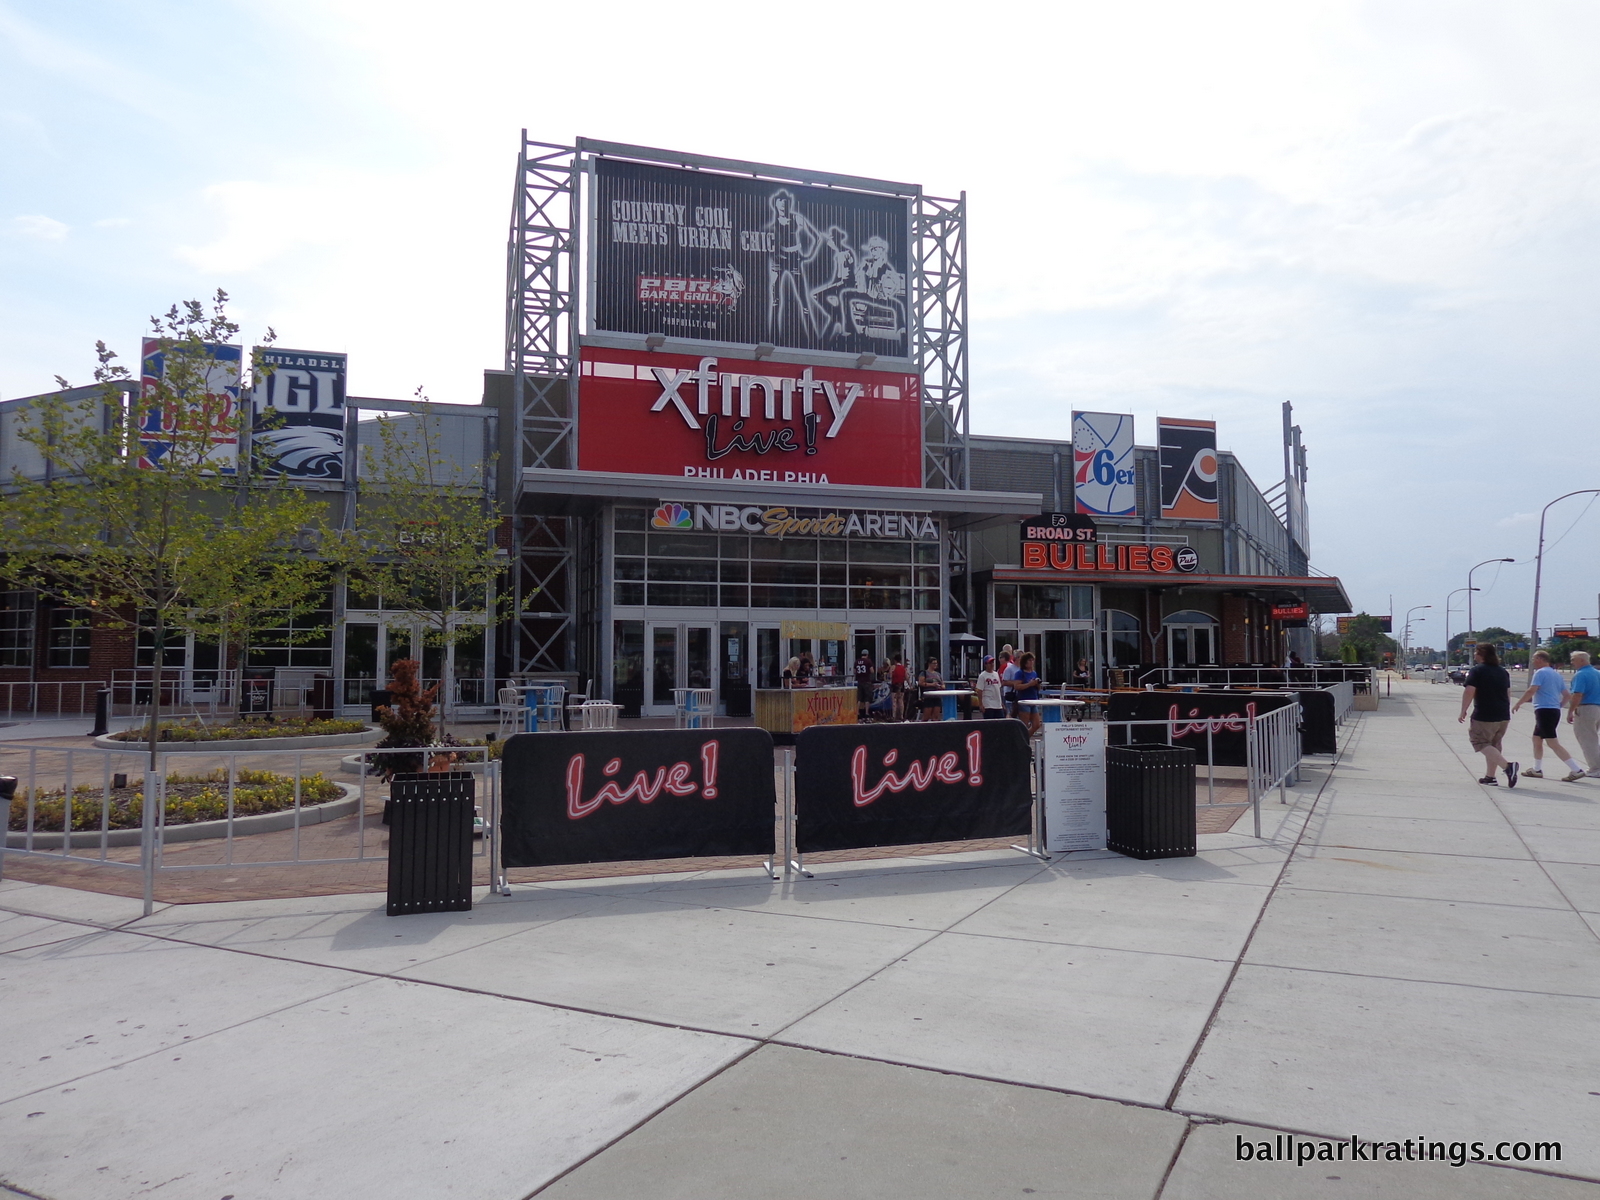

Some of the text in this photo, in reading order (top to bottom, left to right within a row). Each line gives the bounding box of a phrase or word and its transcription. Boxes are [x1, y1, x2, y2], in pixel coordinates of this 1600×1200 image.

[612, 200, 732, 229] COUNTRY COOL
[612, 222, 776, 253] MEETS URBAN CHIC
[640, 278, 712, 293] PBR
[640, 290, 718, 302] BAR & GRILL
[261, 355, 345, 369] HILADEL
[650, 357, 862, 439] xfinity
[706, 412, 819, 461] Live!
[684, 465, 830, 485] PHILADELPHIA
[694, 504, 939, 541] NBC Sports ARENA
[1027, 526, 1096, 541] BROAD ST.
[1021, 542, 1174, 572] BULLIES
[1179, 555, 1197, 564] Pub
[1272, 607, 1304, 615] BULLIES
[856, 665, 867, 674] 33
[806, 692, 844, 716] xfinity
[1168, 702, 1256, 738] Live!
[1063, 735, 1087, 745] xfinity
[566, 739, 719, 820] Live!
[851, 730, 983, 808] Live!
